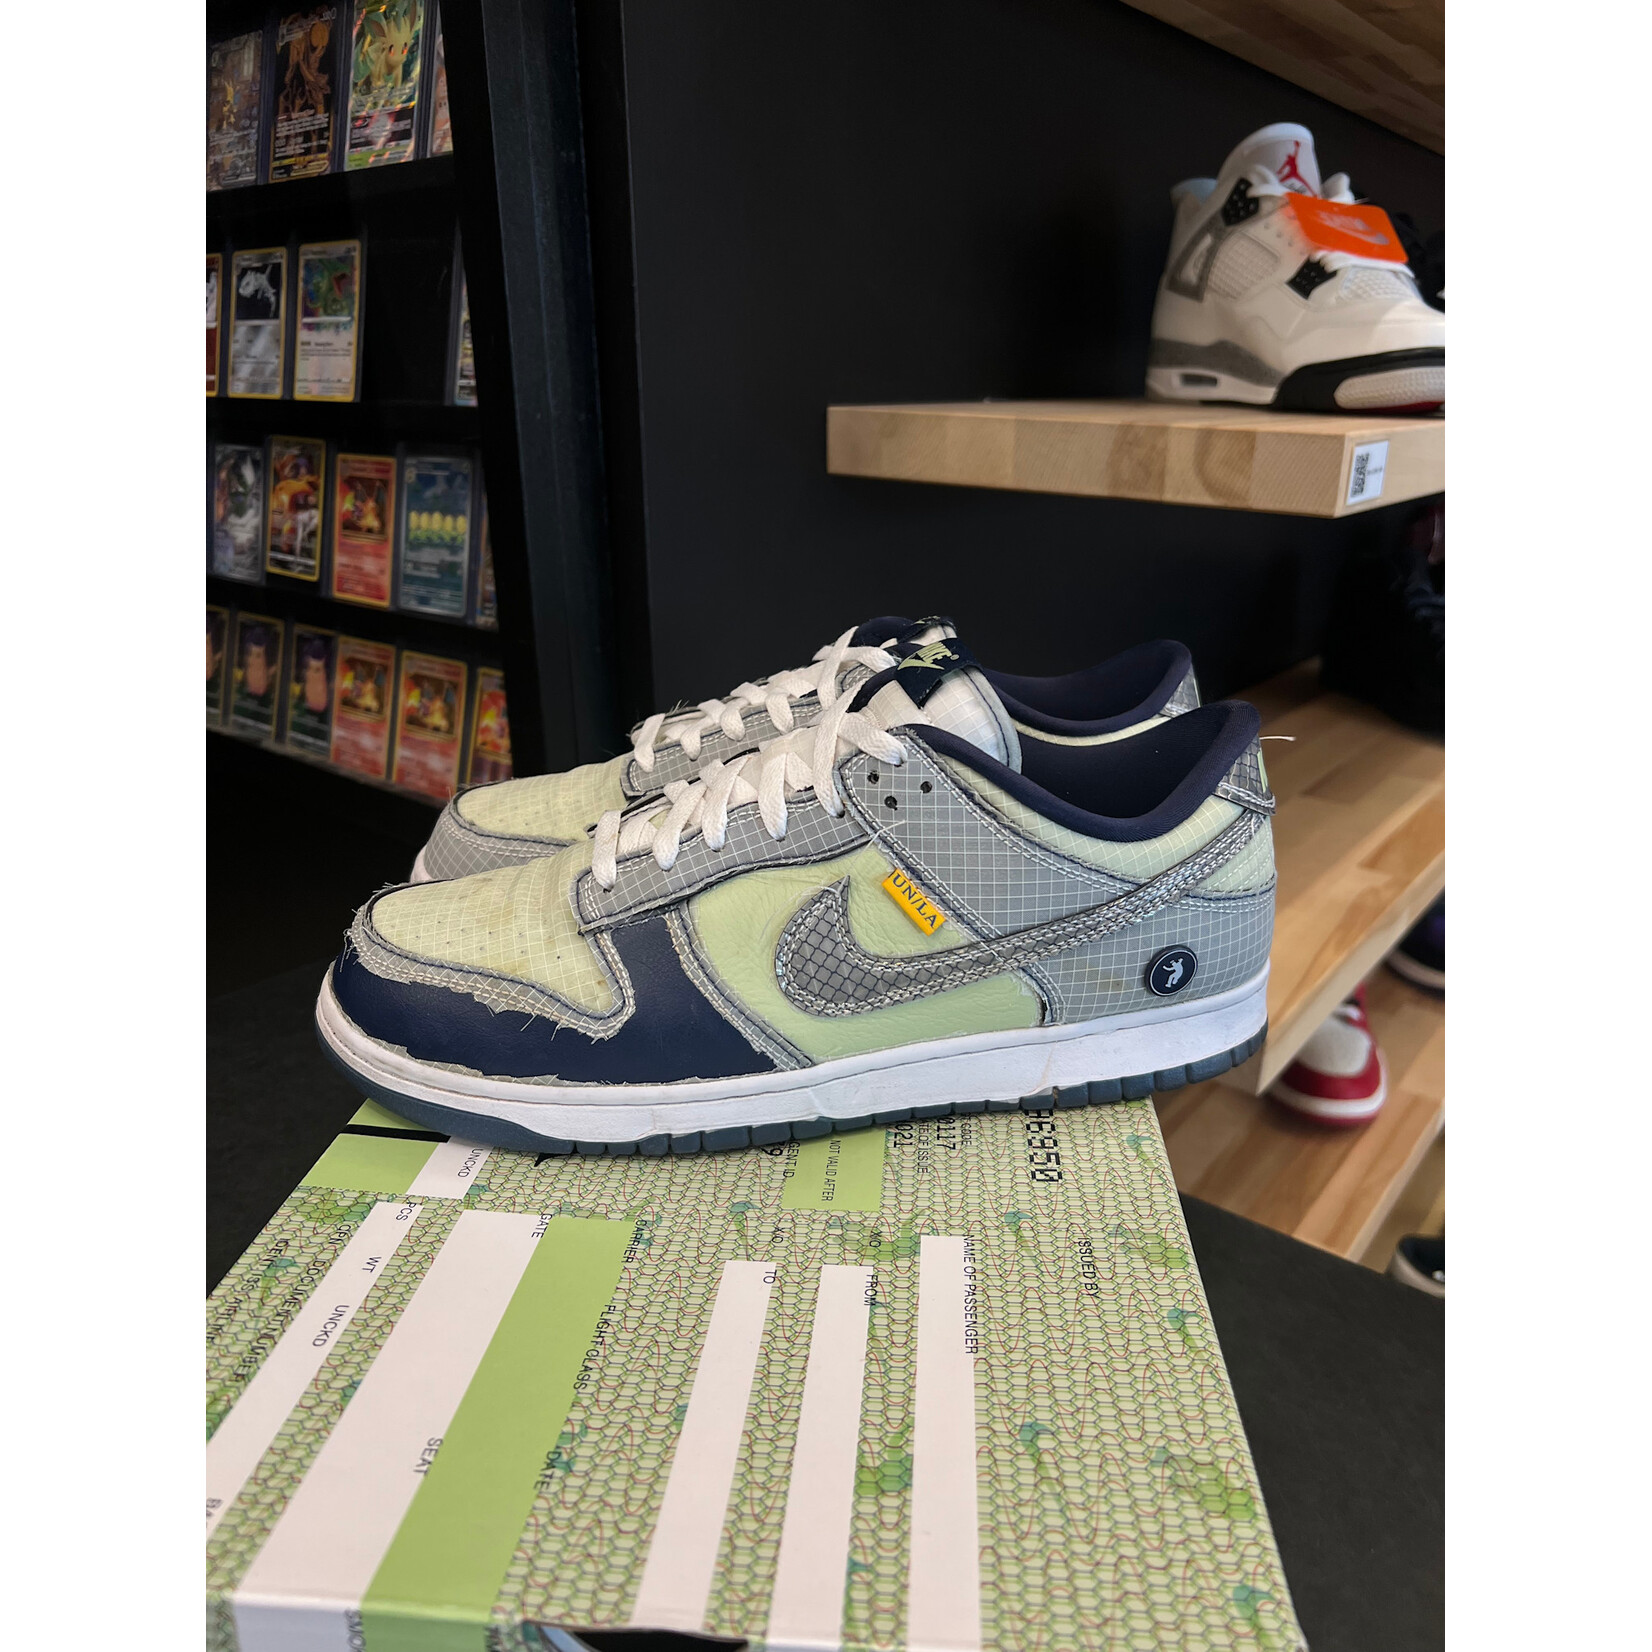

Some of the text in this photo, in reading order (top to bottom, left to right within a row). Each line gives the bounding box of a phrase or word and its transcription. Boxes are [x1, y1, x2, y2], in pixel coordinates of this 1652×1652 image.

[892, 873, 937, 928] UN/LA
[457, 1148, 484, 1178] UNCKD
[782, 1168, 795, 1178] ID
[821, 1139, 842, 1202] NOT VALID AFTER
[917, 1148, 929, 1174] ISSUE
[395, 1201, 417, 1222] PCS
[531, 1213, 553, 1239] GATE
[621, 1219, 648, 1263] CARRIER
[361, 1255, 382, 1274] WT
[763, 1269, 777, 1284] TO
[1077, 1237, 1101, 1300] ISSUED BY
[233, 1224, 352, 1382] CPN DOCUMENT NUMBER
[863, 1274, 879, 1306] FROM
[963, 1233, 979, 1354] NAME OF PASSENGER
[311, 1304, 350, 1348] UNCKD
[573, 1304, 616, 1391] FLIGHT CLASS
[413, 1437, 444, 1477] SEAT
[533, 1450, 562, 1491] DATE
